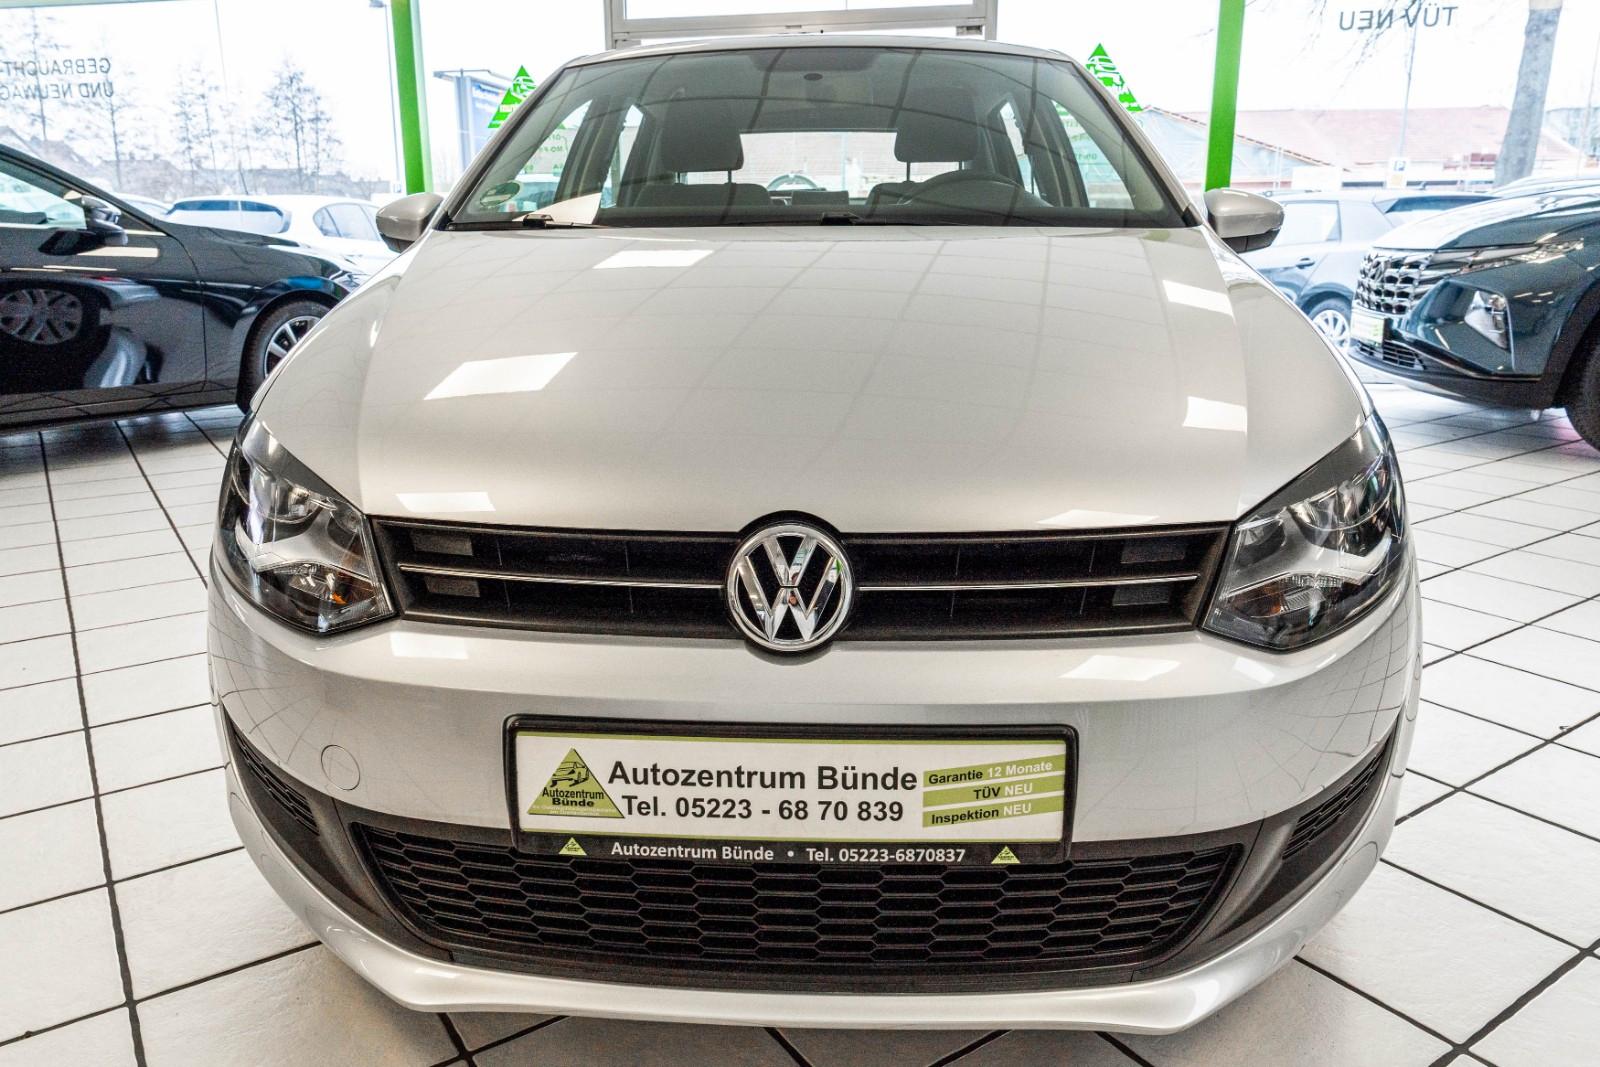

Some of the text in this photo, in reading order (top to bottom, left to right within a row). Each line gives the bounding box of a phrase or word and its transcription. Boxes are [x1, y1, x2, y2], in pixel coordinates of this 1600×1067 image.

[734, 532, 845, 645] VW
[608, 760, 917, 790] Autozentrum Bünde
[929, 761, 1053, 785] Garantie 12 Monate
[542, 787, 604, 800] Autozentrum
[973, 783, 1033, 799] TÜV NEU
[552, 797, 594, 807] Bünde
[621, 795, 666, 817] Tel.
[676, 797, 752, 819] 05223
[778, 800, 808, 820] 68
[818, 800, 848, 821] 70
[857, 801, 904, 821] 839
[931, 803, 1032, 825] Inspektion NEU
[611, 842, 774, 861] Autozentrum Bünde
[806, 848, 966, 862] Tel. 05223-6870837
